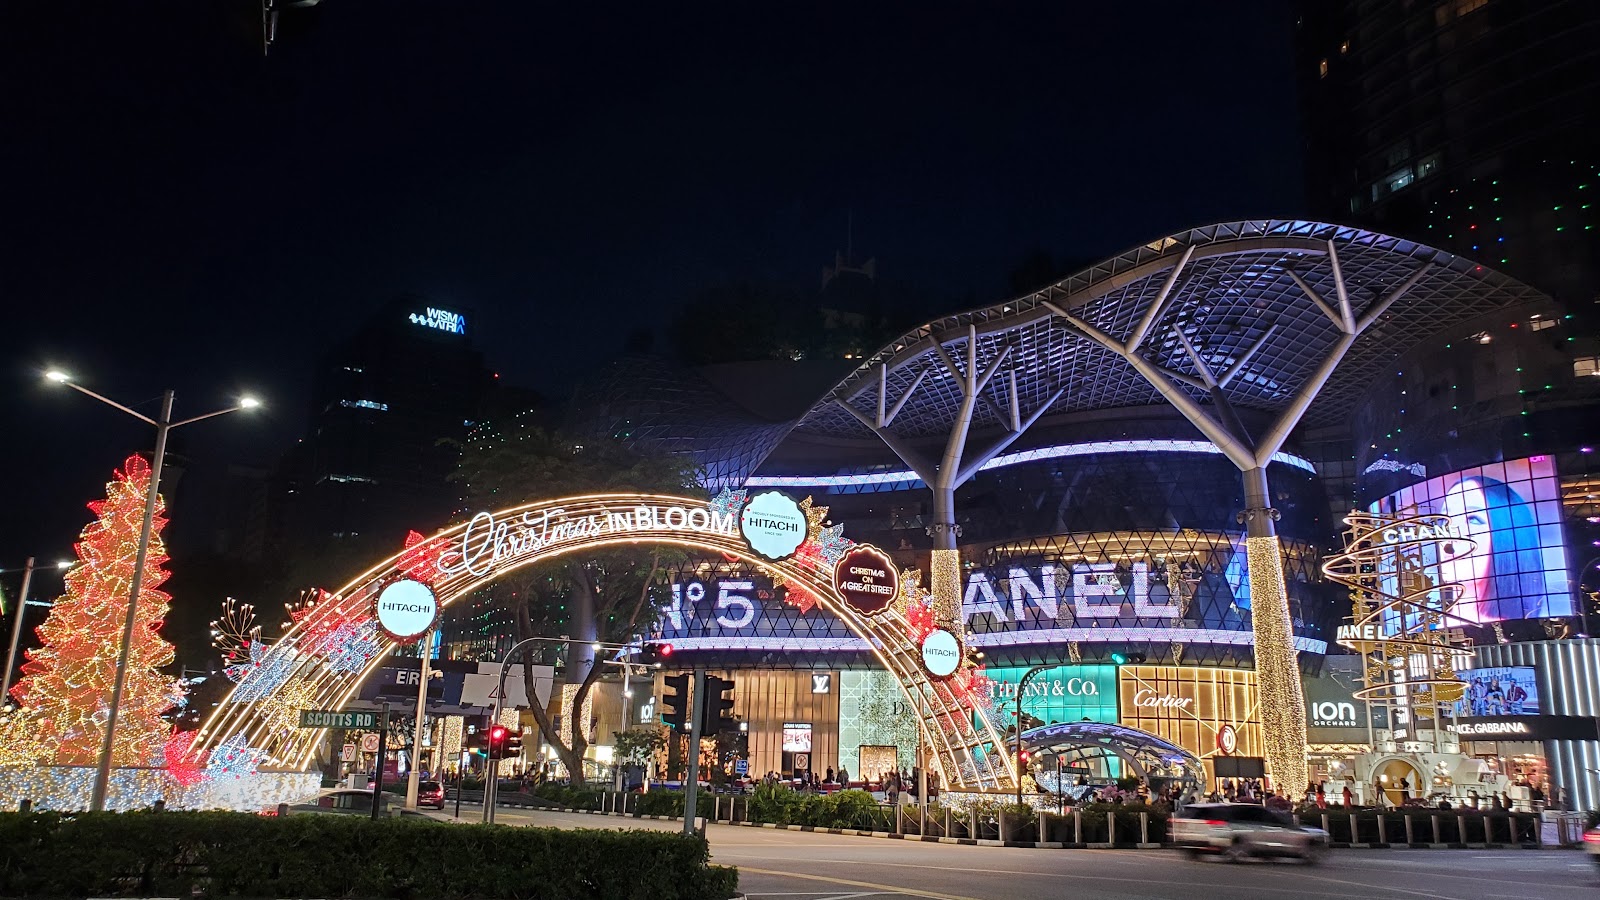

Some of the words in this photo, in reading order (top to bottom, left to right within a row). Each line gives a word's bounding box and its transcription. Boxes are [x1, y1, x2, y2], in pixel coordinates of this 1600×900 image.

[427, 306, 465, 325] WISMA
[434, 320, 464, 334] ATRIA
[607, 511, 632, 533] IN
[634, 505, 733, 536] BLOOM
[749, 517, 798, 532] HITACHI
[849, 566, 885, 578] CHRISTMAS
[861, 575, 873, 584] ON
[840, 581, 847, 589] A
[846, 581, 870, 593] GREAT
[870, 584, 893, 595] STREET
[382, 602, 430, 613] HITACHI
[717, 581, 755, 629] 5
[925, 648, 957, 657] HITACHI
[1133, 689, 1193, 708] Cartier
[307, 713, 352, 726] SCOTTS
[355, 713, 372, 727] RD
